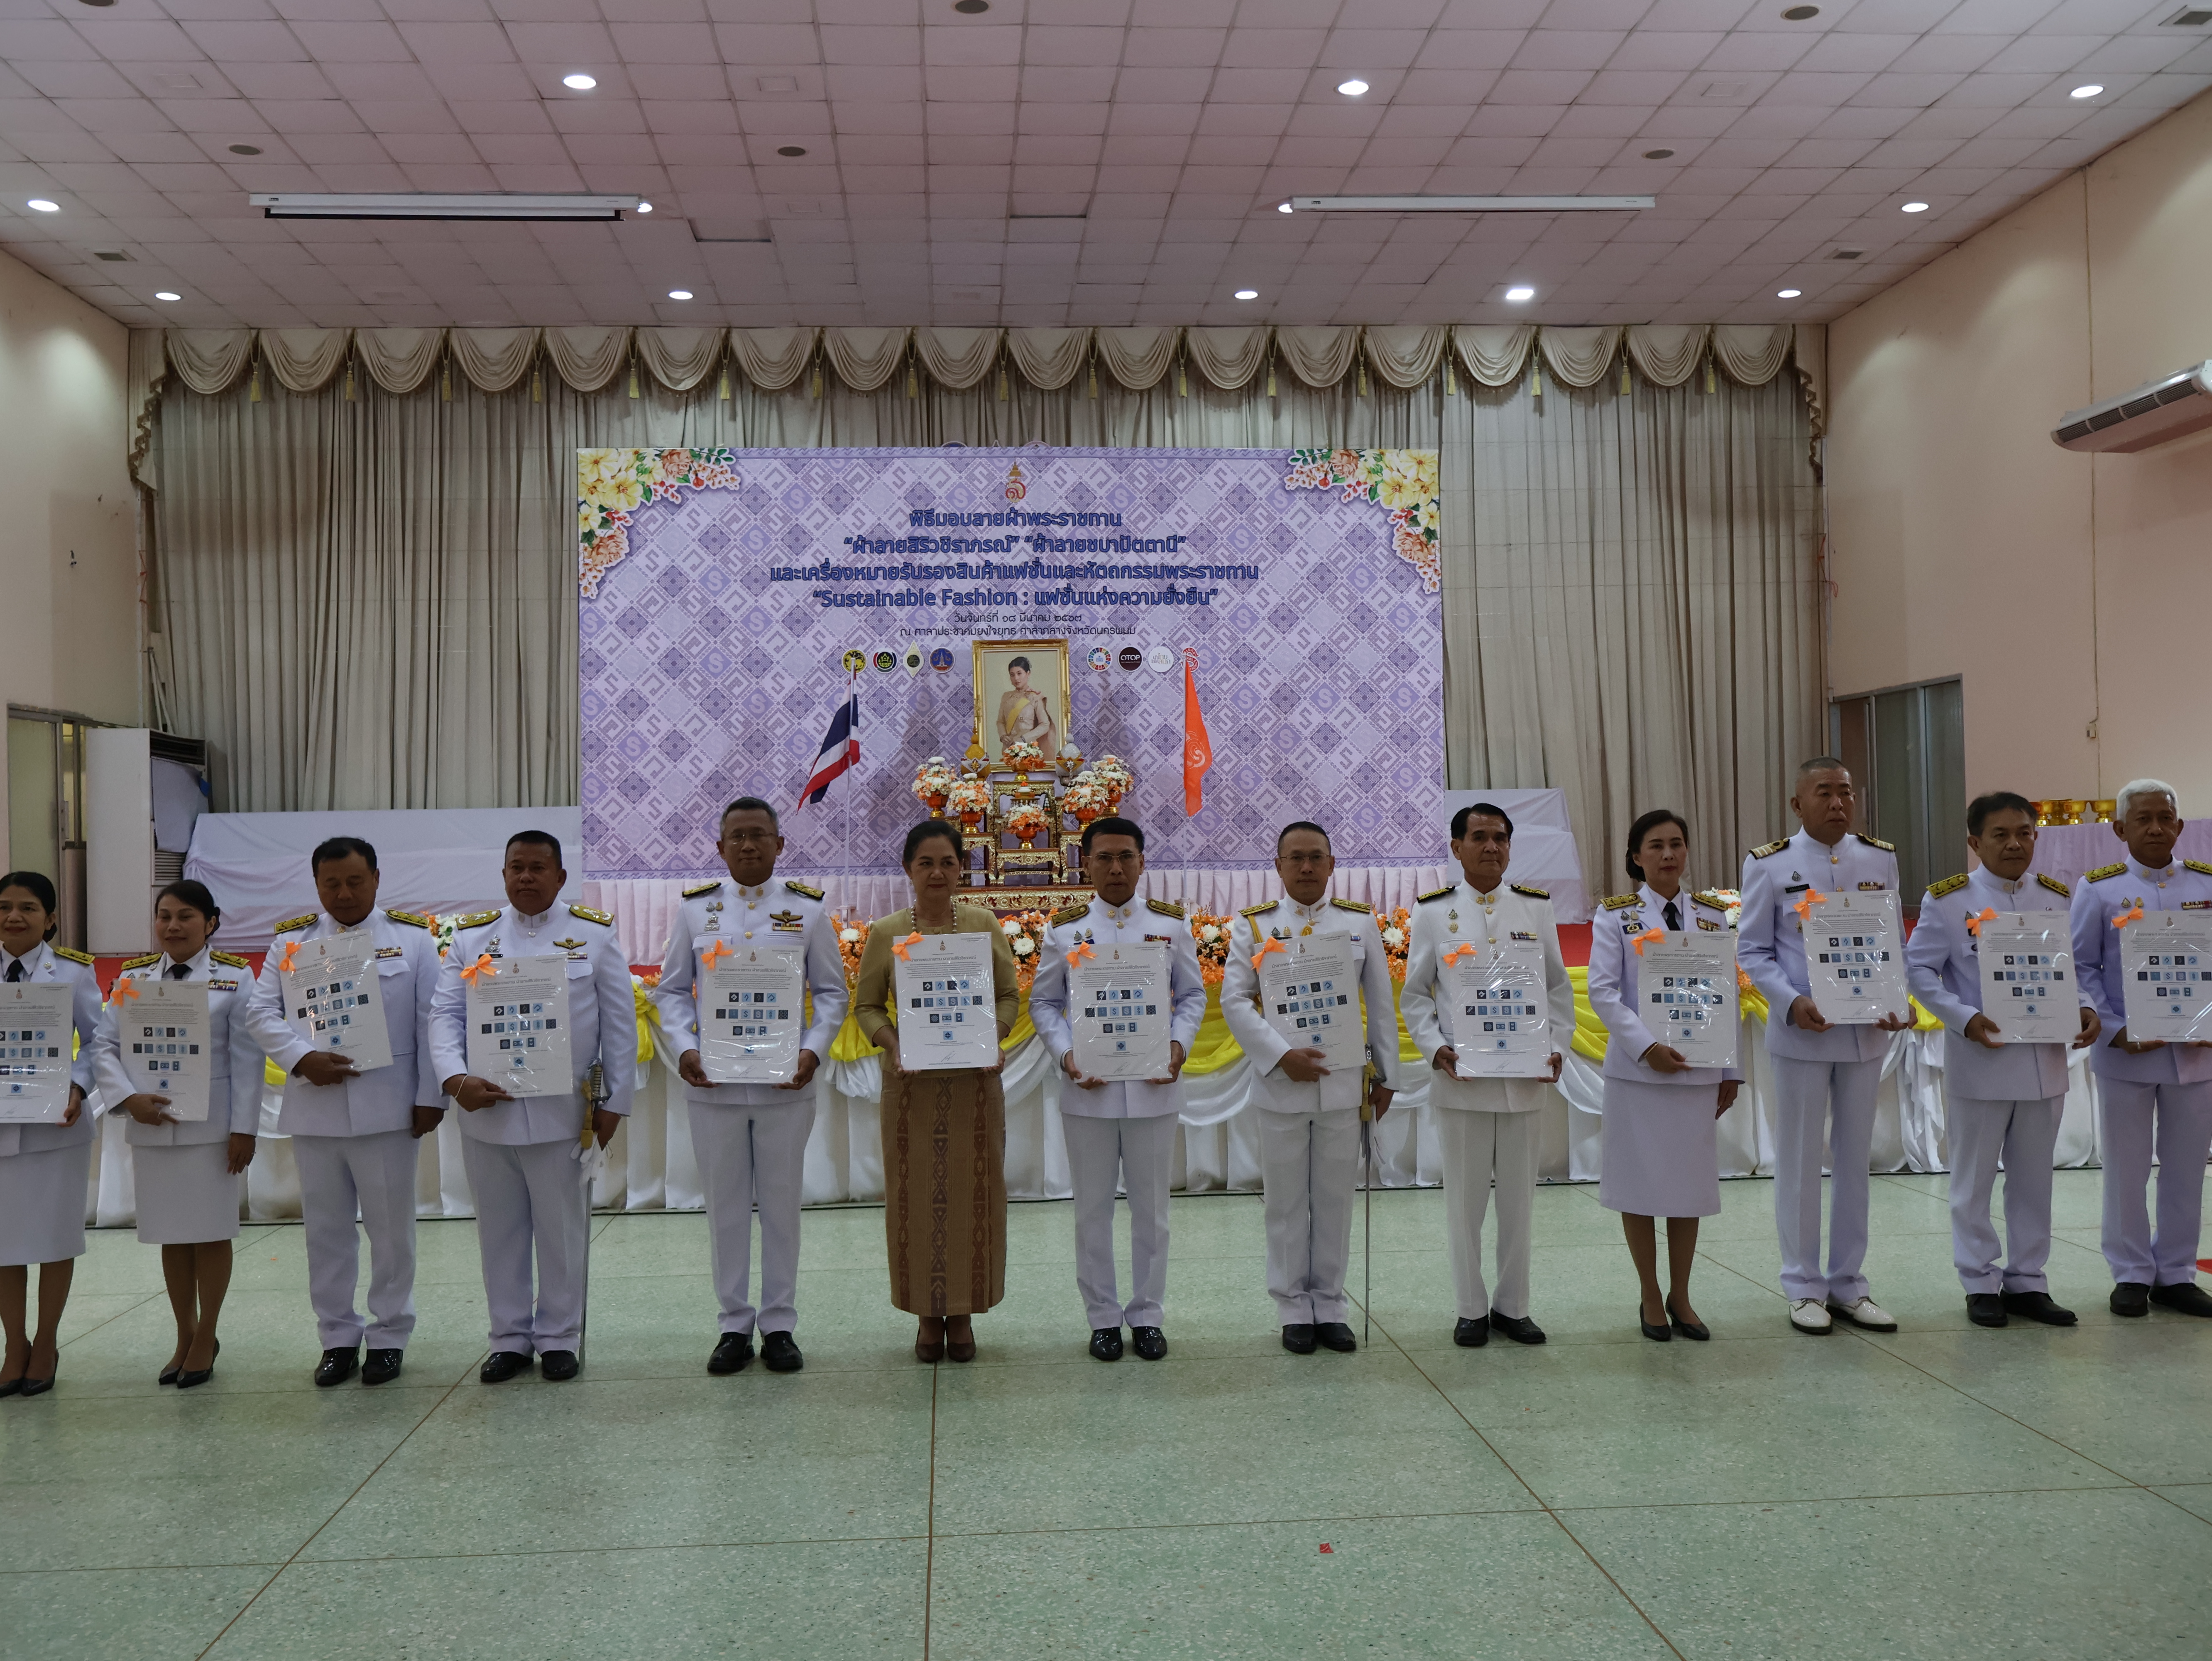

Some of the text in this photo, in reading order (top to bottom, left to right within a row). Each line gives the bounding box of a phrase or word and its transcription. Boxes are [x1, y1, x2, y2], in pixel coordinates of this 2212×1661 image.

[909, 507, 1121, 527] พิธีมอบลายผ้าพระราชทาน
[771, 557, 1258, 581] และเครื่องหมายรับรองสินค้าแฟชั่นและหัตถกรรมพระราชทาน
[942, 588, 1018, 606] Fashion
[954, 610, 998, 622] วันจันทร์ที่
[1020, 612, 1050, 622] มีนาคม
[915, 625, 1016, 637] ศาลาประชาคมยงใจยุทธ
[1020, 625, 1135, 635] ศาลากลางจังหวัดนครพนม
